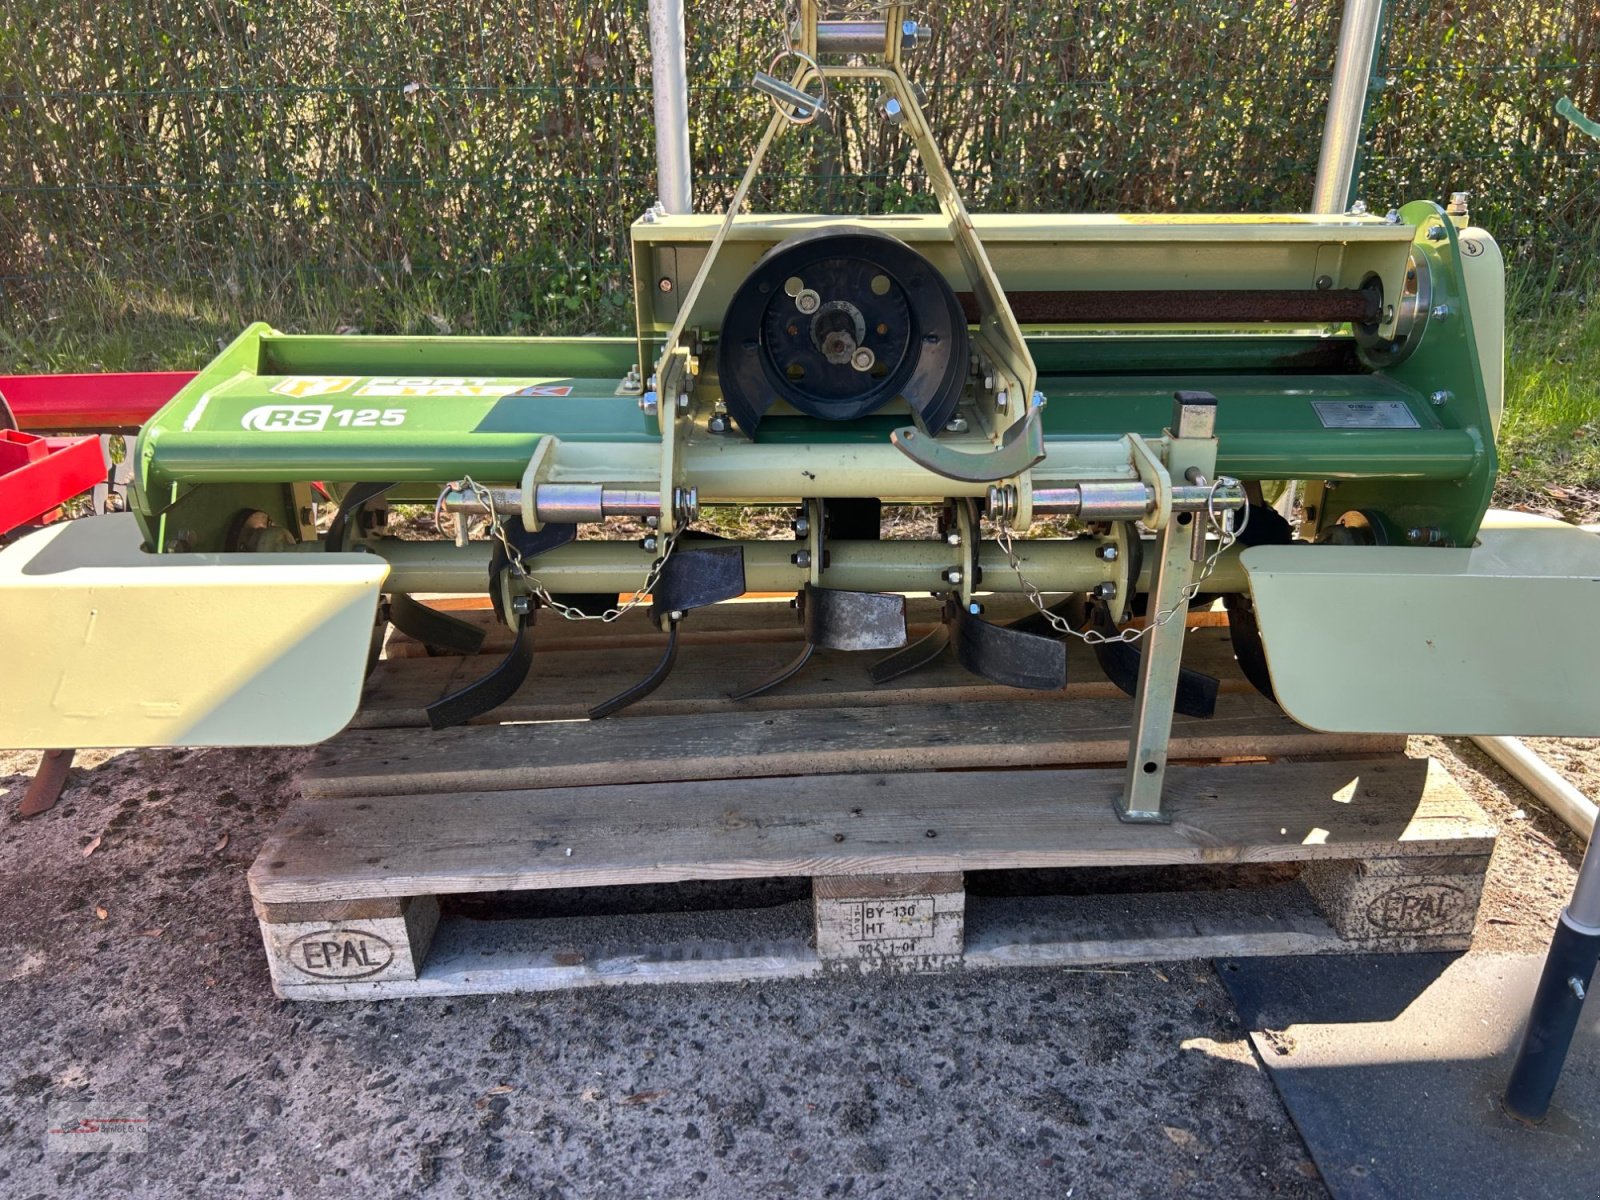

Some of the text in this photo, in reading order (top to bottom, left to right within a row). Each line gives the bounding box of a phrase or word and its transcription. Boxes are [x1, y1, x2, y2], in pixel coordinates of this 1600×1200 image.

[264, 409, 407, 427] RS 125
[1382, 890, 1450, 922] EPAL
[866, 922, 885, 934] HT
[302, 941, 381, 969] EPAL
